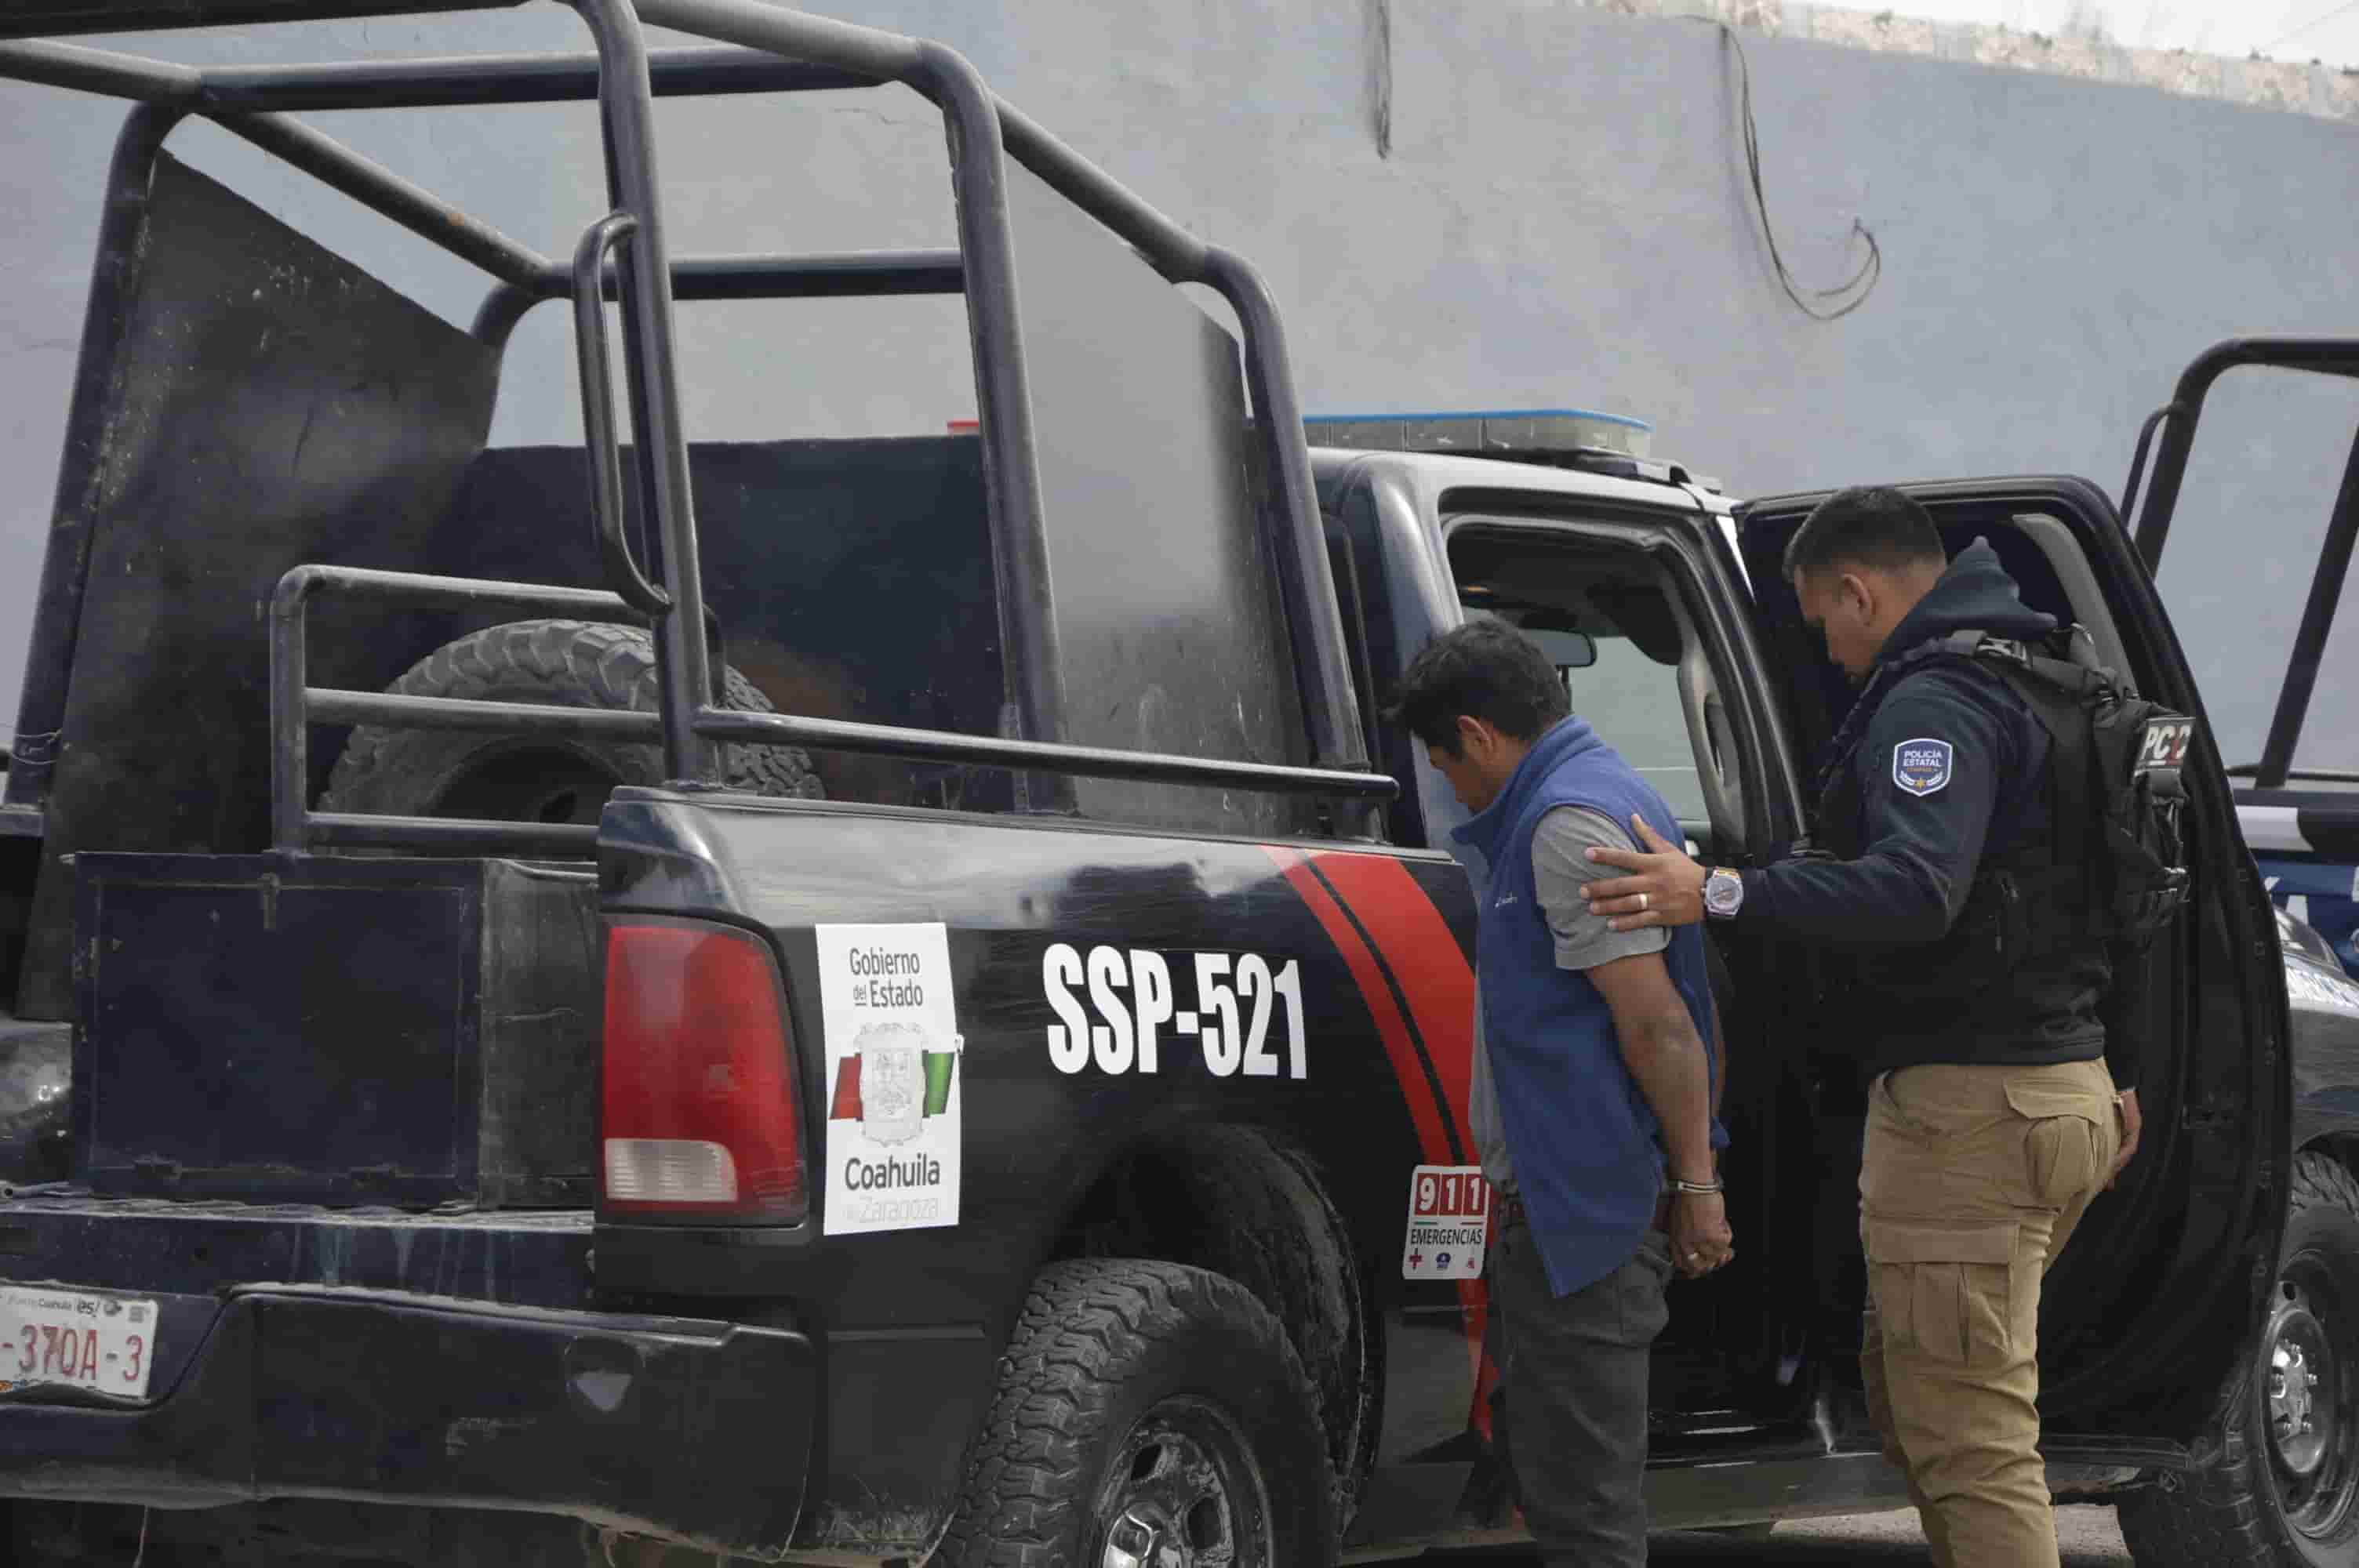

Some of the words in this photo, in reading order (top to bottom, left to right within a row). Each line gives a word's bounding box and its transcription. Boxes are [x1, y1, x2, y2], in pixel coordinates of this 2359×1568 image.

[849, 947, 920, 976] Gobierno
[853, 985, 867, 1002] del
[871, 980, 923, 1007] Estado
[1042, 943, 1307, 1079] SSP-521
[845, 1152, 941, 1191] Coahuila
[1419, 1178, 1481, 1211] 911
[859, 1197, 939, 1225] Zaragoza
[1411, 1229, 1482, 1245] EMERGENCIAS
